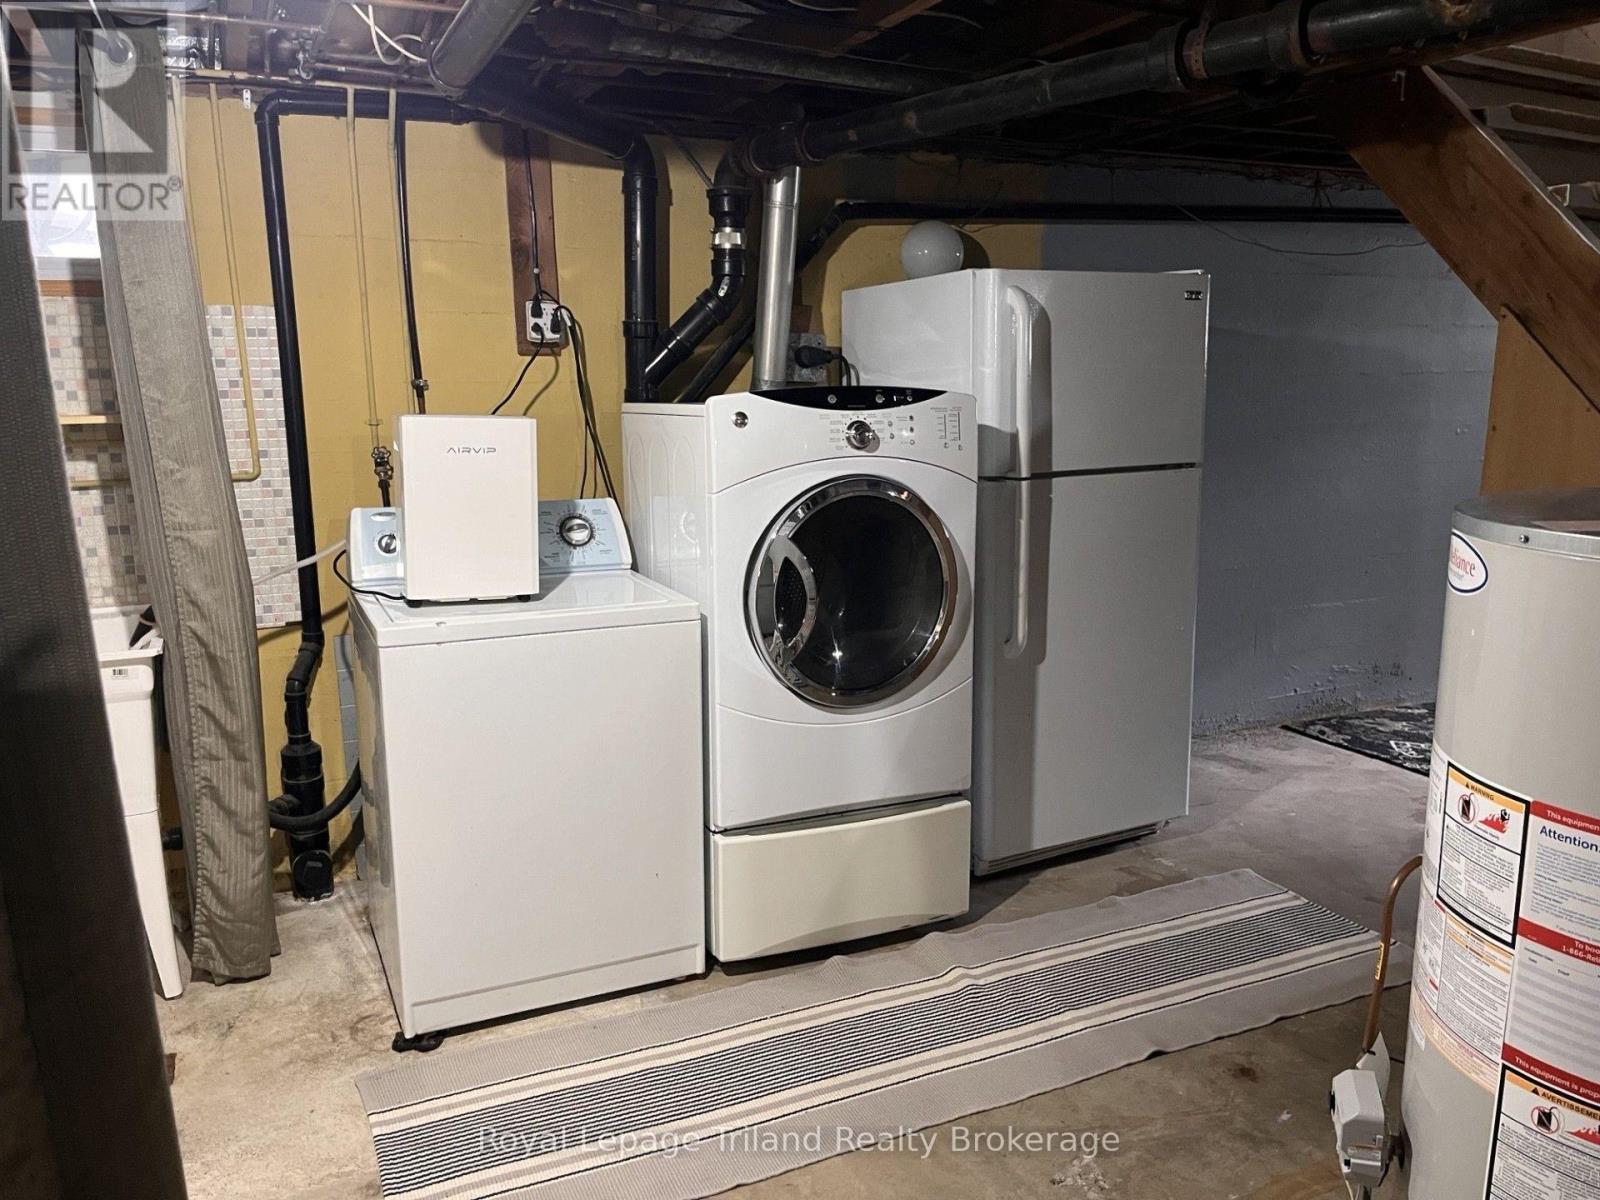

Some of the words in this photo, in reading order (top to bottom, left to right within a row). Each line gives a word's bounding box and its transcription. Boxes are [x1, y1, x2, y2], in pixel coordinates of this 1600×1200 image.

[1470, 784, 1495, 801] WARNING
[1546, 809, 1561, 821] This
[1515, 1055, 1529, 1069] This
[1530, 1065, 1570, 1088] equipment
[1571, 1083, 1579, 1091] is
